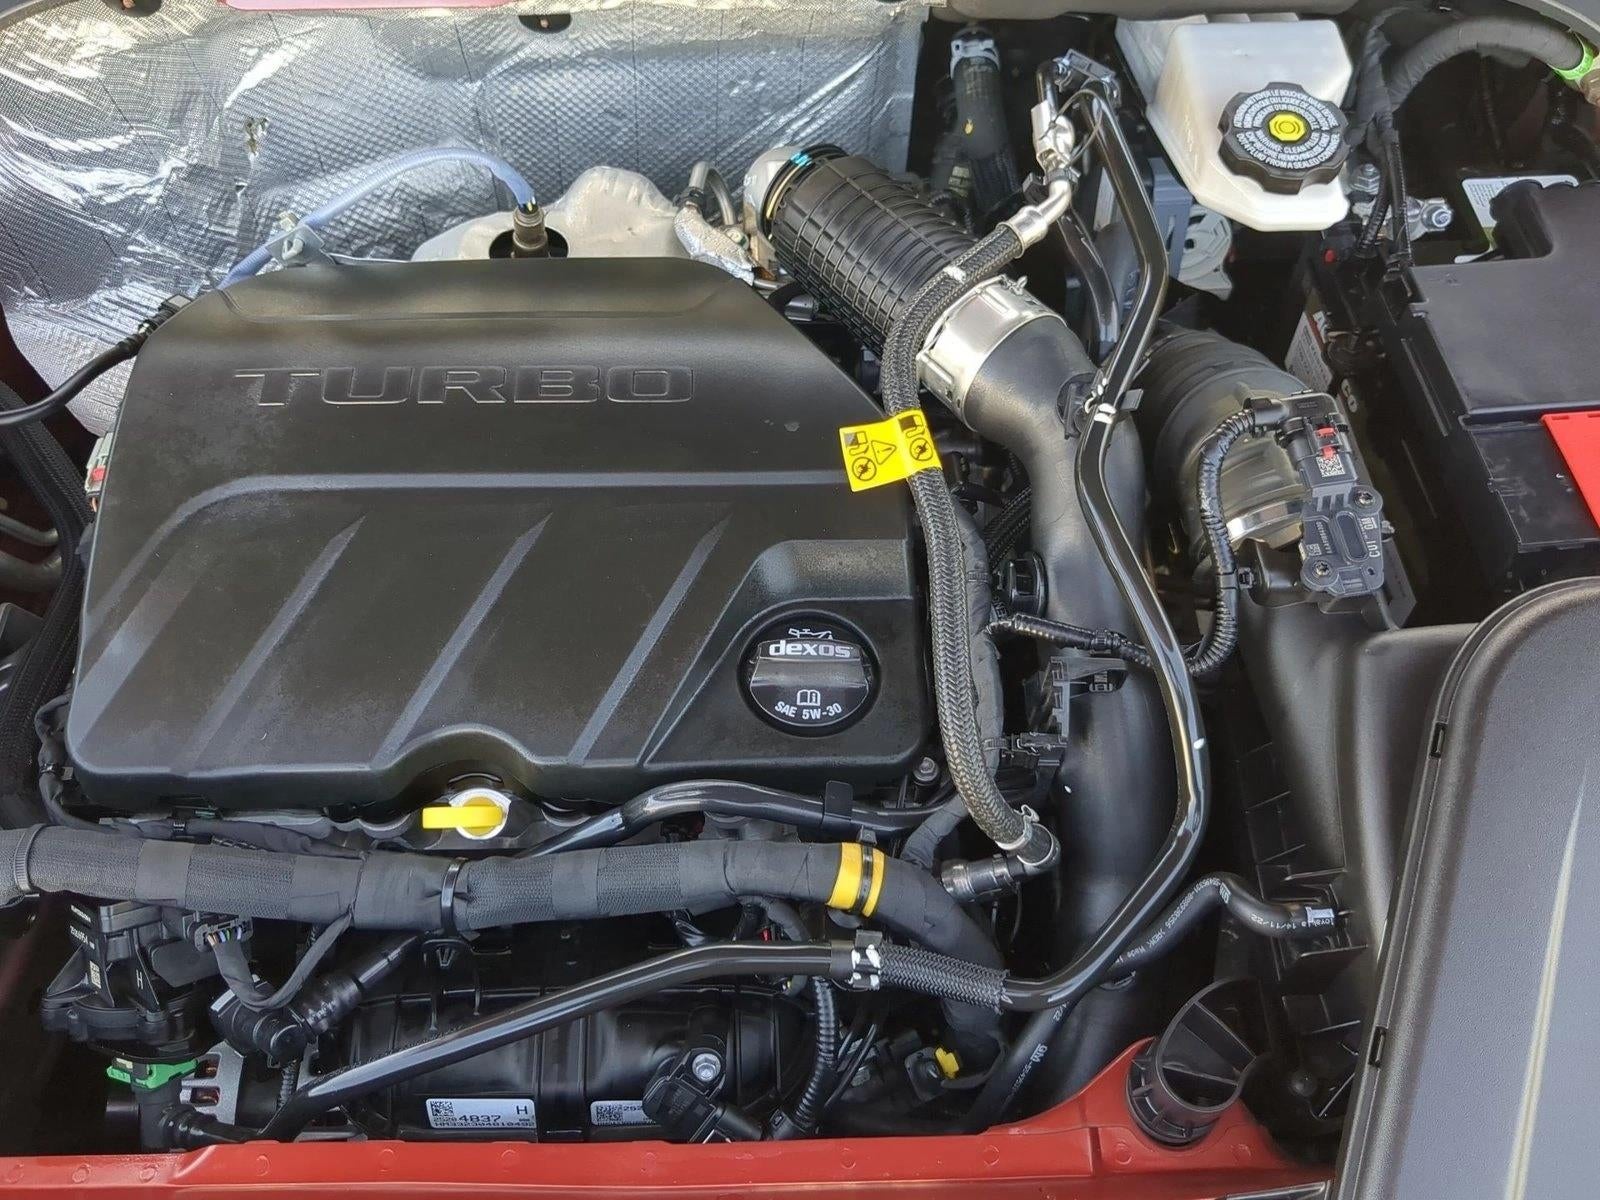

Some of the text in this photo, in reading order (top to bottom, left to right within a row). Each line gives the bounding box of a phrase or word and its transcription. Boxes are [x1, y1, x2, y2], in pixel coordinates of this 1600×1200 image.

[1247, 146, 1267, 161] FLUID
[1265, 157, 1288, 168] FROM
[1293, 157, 1321, 169] SEALED
[1283, 144, 1307, 154] CLEAN
[235, 365, 696, 408] TURBO
[768, 640, 852, 659] dexos
[774, 701, 843, 720] SAE 5W-30
[135, 969, 144, 990] H
[515, 1105, 528, 1115] H
